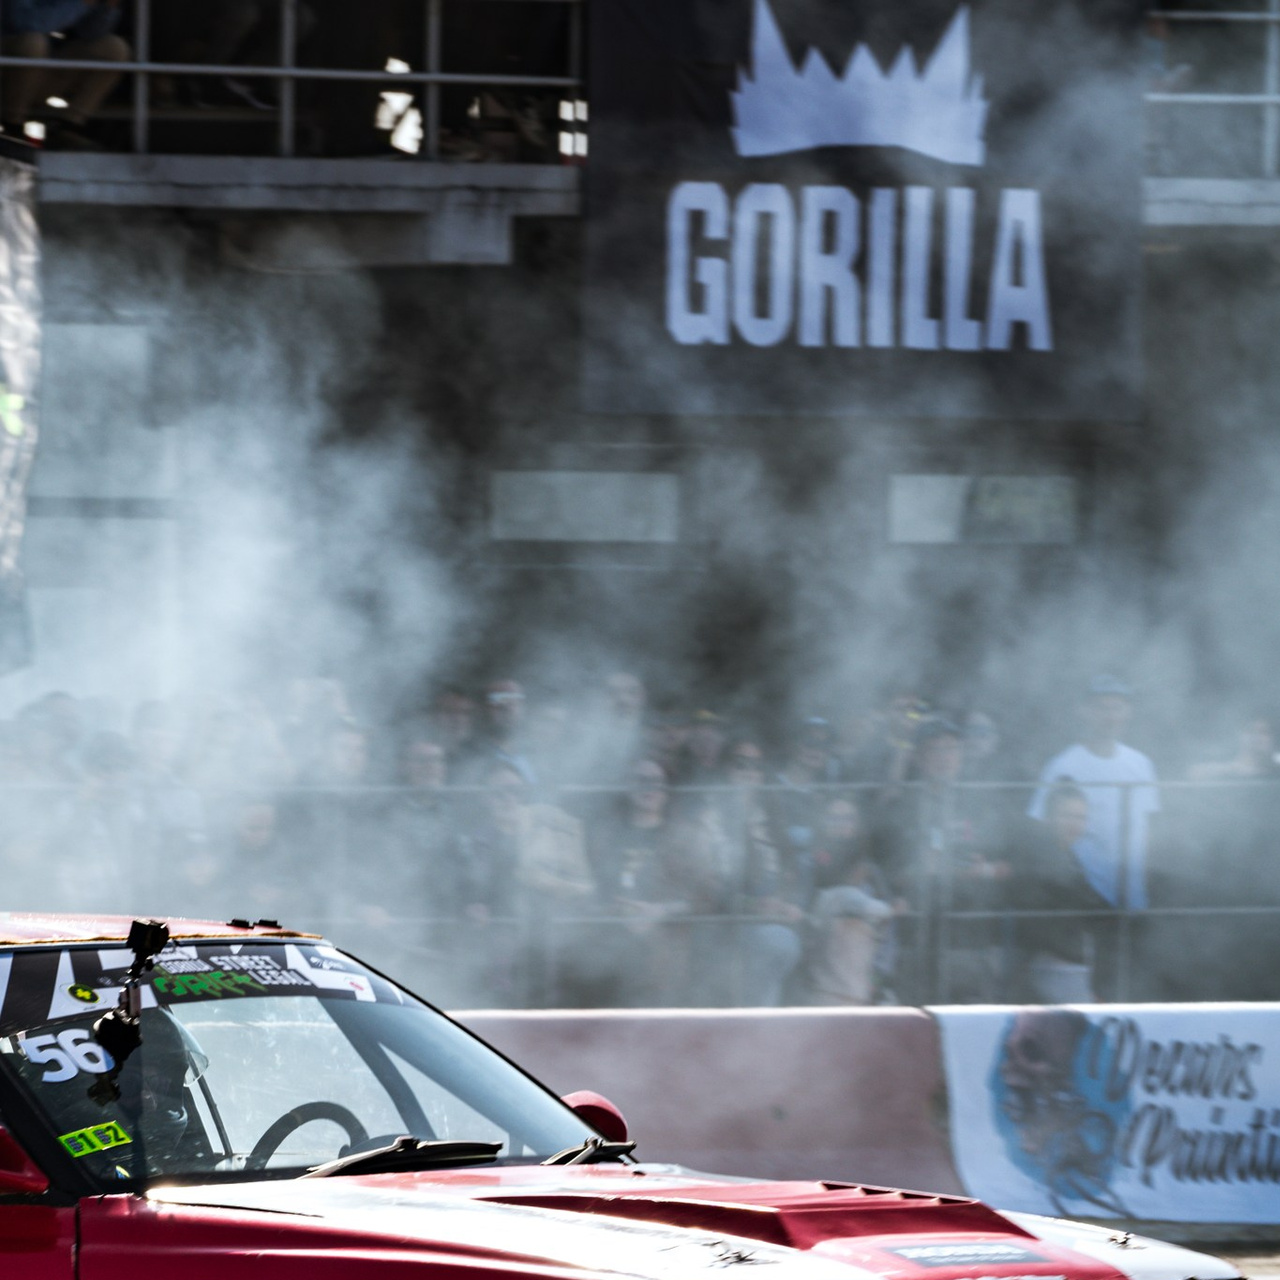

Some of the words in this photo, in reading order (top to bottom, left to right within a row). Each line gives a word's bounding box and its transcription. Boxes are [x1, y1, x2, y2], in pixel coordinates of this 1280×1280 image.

[665, 181, 1054, 351] GORILLA
[209, 955, 281, 971] STREET
[248, 970, 312, 986] LEGAL
[17, 1028, 115, 1083] 56
